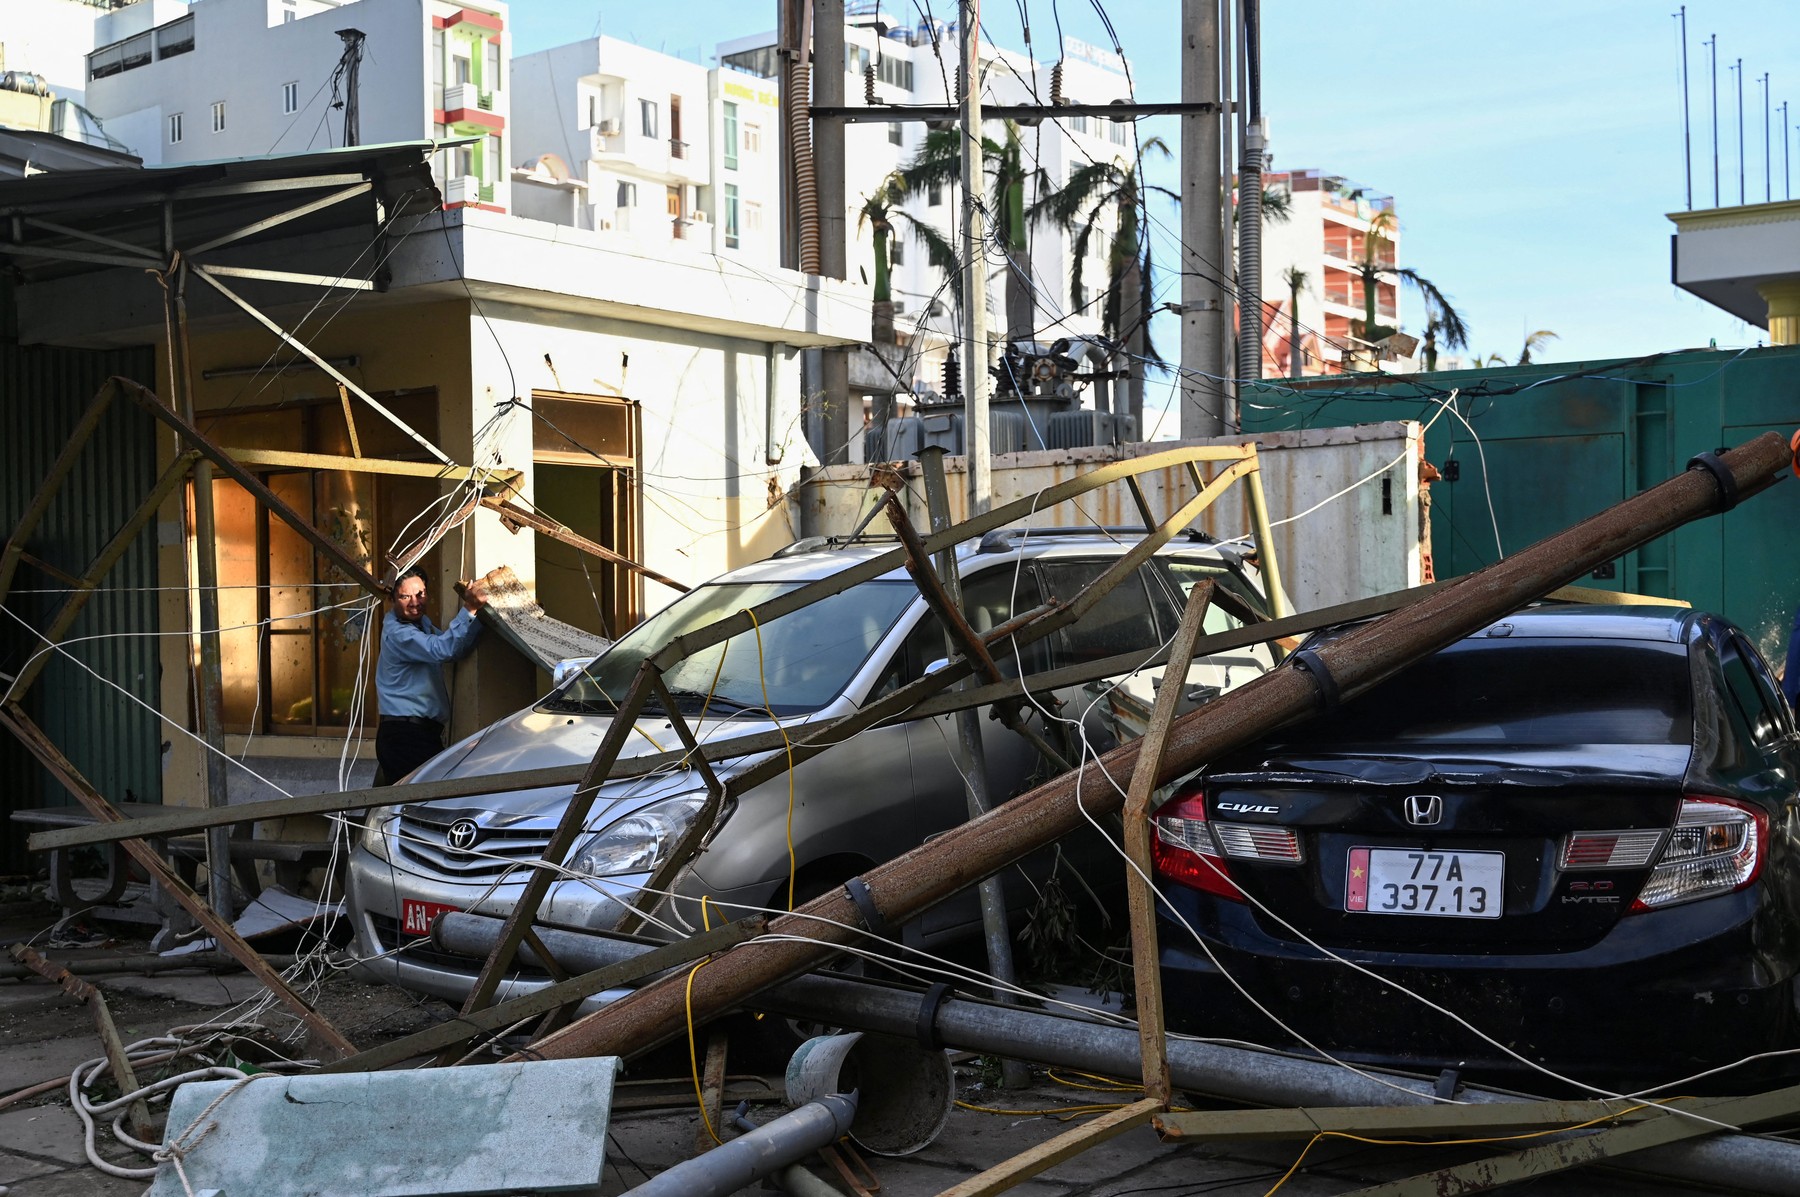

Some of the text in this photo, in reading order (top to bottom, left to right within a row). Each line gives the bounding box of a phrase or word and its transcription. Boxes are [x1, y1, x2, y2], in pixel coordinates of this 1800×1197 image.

[1217, 802, 1279, 814] CIVIC
[1408, 853, 1463, 882] 77A
[1570, 880, 1614, 890] 2.0
[1349, 895, 1364, 903] VIE
[1382, 883, 1487, 914] 337.13
[406, 903, 450, 932] AN-
